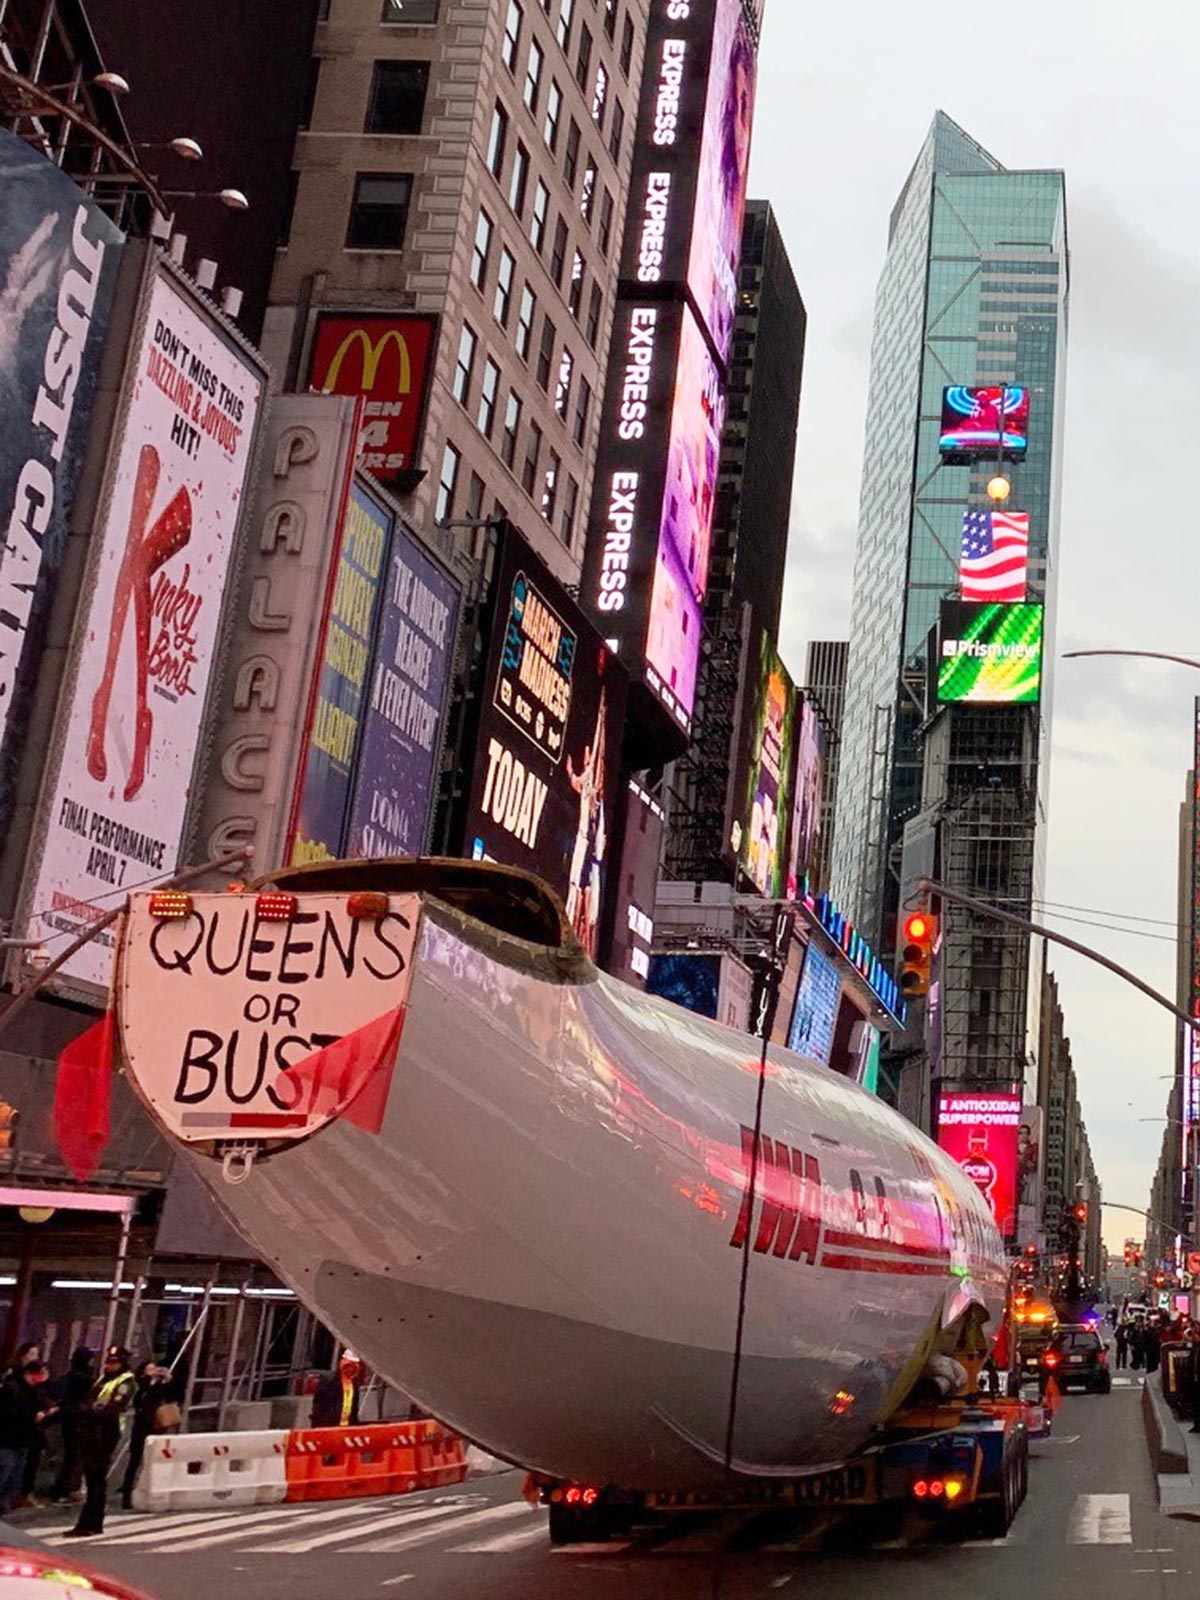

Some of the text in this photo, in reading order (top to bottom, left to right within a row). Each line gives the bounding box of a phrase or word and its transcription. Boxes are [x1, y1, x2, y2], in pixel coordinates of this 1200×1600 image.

[653, 38, 686, 146] EXPRESS
[637, 172, 671, 283] EXPRESS
[32, 204, 105, 461] JUST
[154, 318, 244, 423] DON'T MISS THIS
[192, 391, 203, 425] &
[619, 307, 657, 441] EXPRESS
[170, 414, 202, 460] HIT!
[598, 471, 639, 613] EXPRESS
[207, 425, 321, 877] PALACE
[521, 590, 562, 663] MARCH
[958, 639, 1038, 658] Prismview
[518, 639, 570, 723] MADNESS
[59, 797, 166, 870] FINAL PERFORMANCE
[481, 737, 548, 850] TODAY
[86, 846, 127, 887] APRIL 7
[149, 908, 411, 984] QUEENS
[243, 993, 301, 1028] OR
[938, 1114, 1020, 1126] SUPERPOWER
